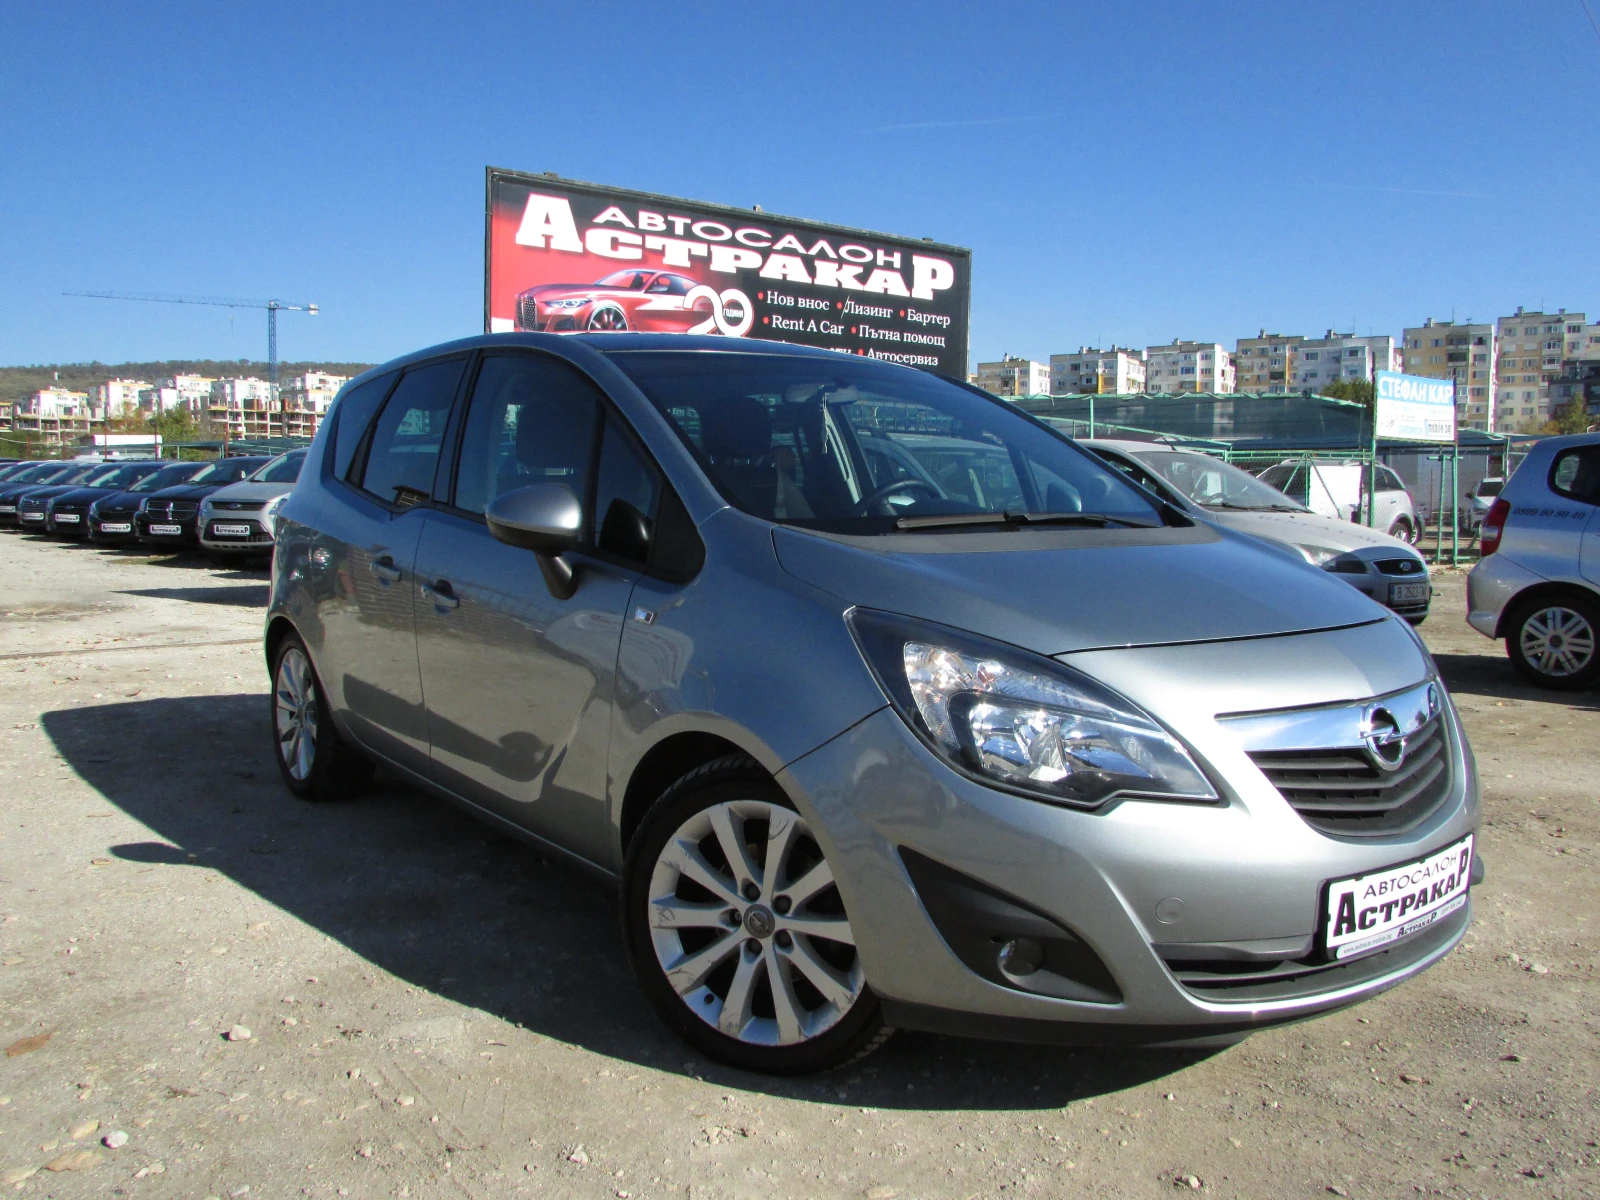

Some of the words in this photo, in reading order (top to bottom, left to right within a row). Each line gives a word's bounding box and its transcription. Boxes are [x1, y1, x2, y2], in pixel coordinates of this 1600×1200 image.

[515, 193, 954, 300] АСТРАКАР
[592, 206, 902, 268] АВТОСАЛОН
[683, 284, 754, 338] 20
[766, 290, 795, 307] Нов
[797, 296, 830, 311] внос
[844, 300, 893, 319] Лизинг
[907, 308, 950, 327] Бартер
[771, 315, 804, 332] Rent
[806, 319, 818, 333] A
[819, 320, 845, 336] Car
[859, 324, 901, 343] Пътна
[903, 332, 946, 349] помощ
[867, 348, 938, 366] Автосервиз
[1379, 376, 1427, 402] СТЕФАН
[1428, 384, 1454, 404] КАР
[1332, 847, 1469, 937] АСТРАКАР
[1363, 852, 1457, 900] АВТОСАЛОН
